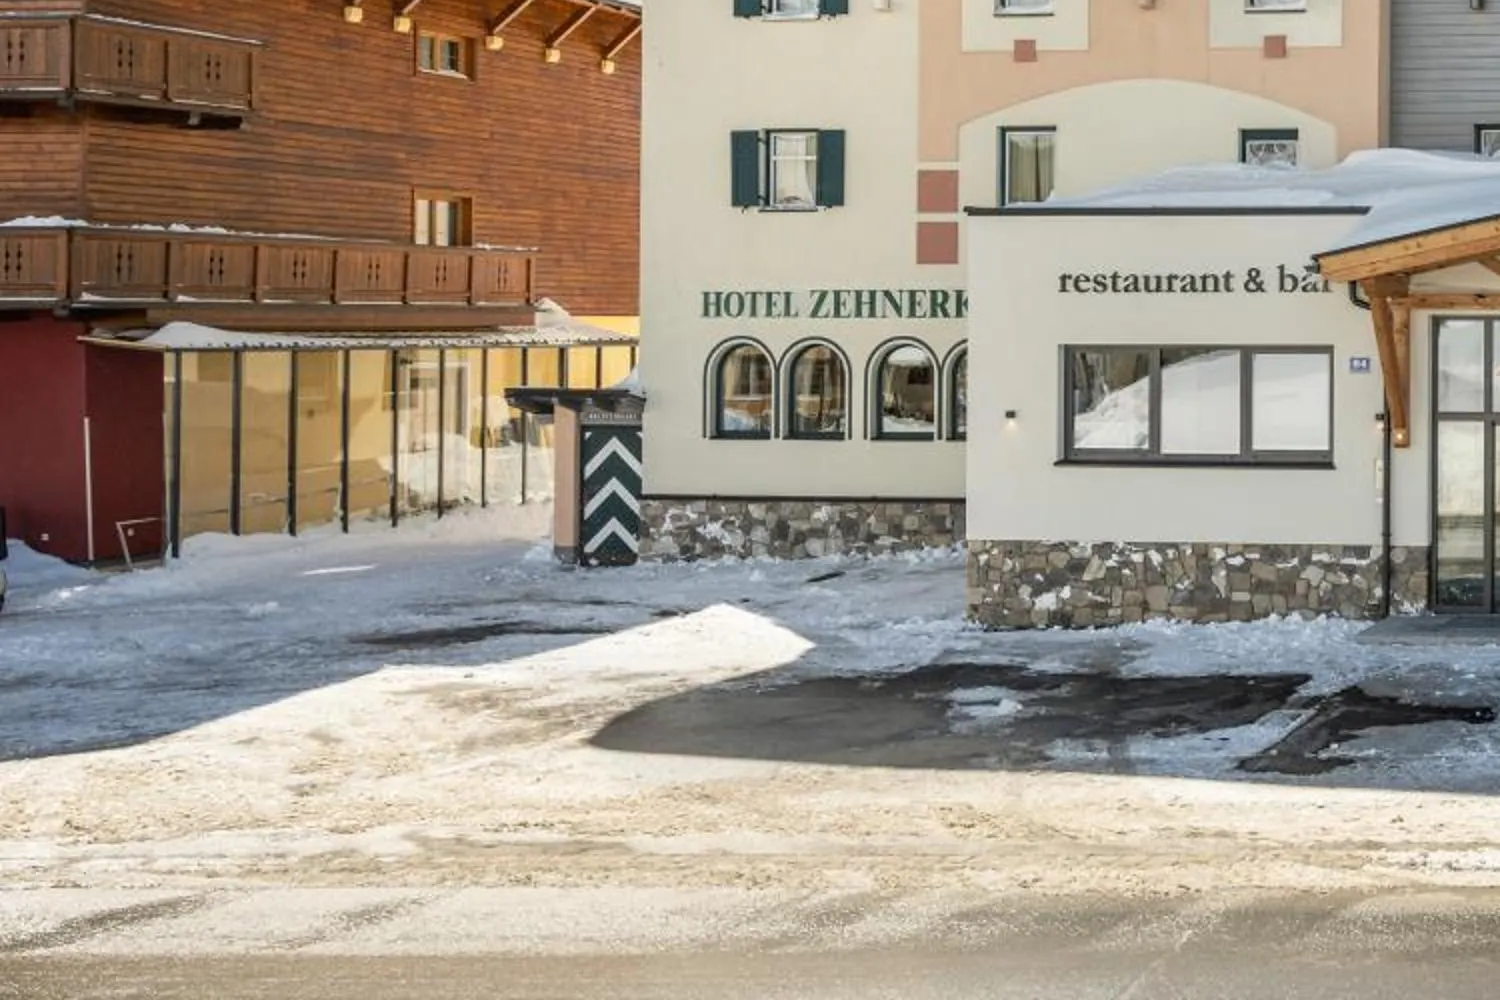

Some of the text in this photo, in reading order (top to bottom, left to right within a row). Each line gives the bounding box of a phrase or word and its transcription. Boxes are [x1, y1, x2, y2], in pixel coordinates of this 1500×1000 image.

[1058, 269, 1234, 293] restaurant
[1243, 267, 1267, 293] &
[701, 291, 798, 318] HOTEL
